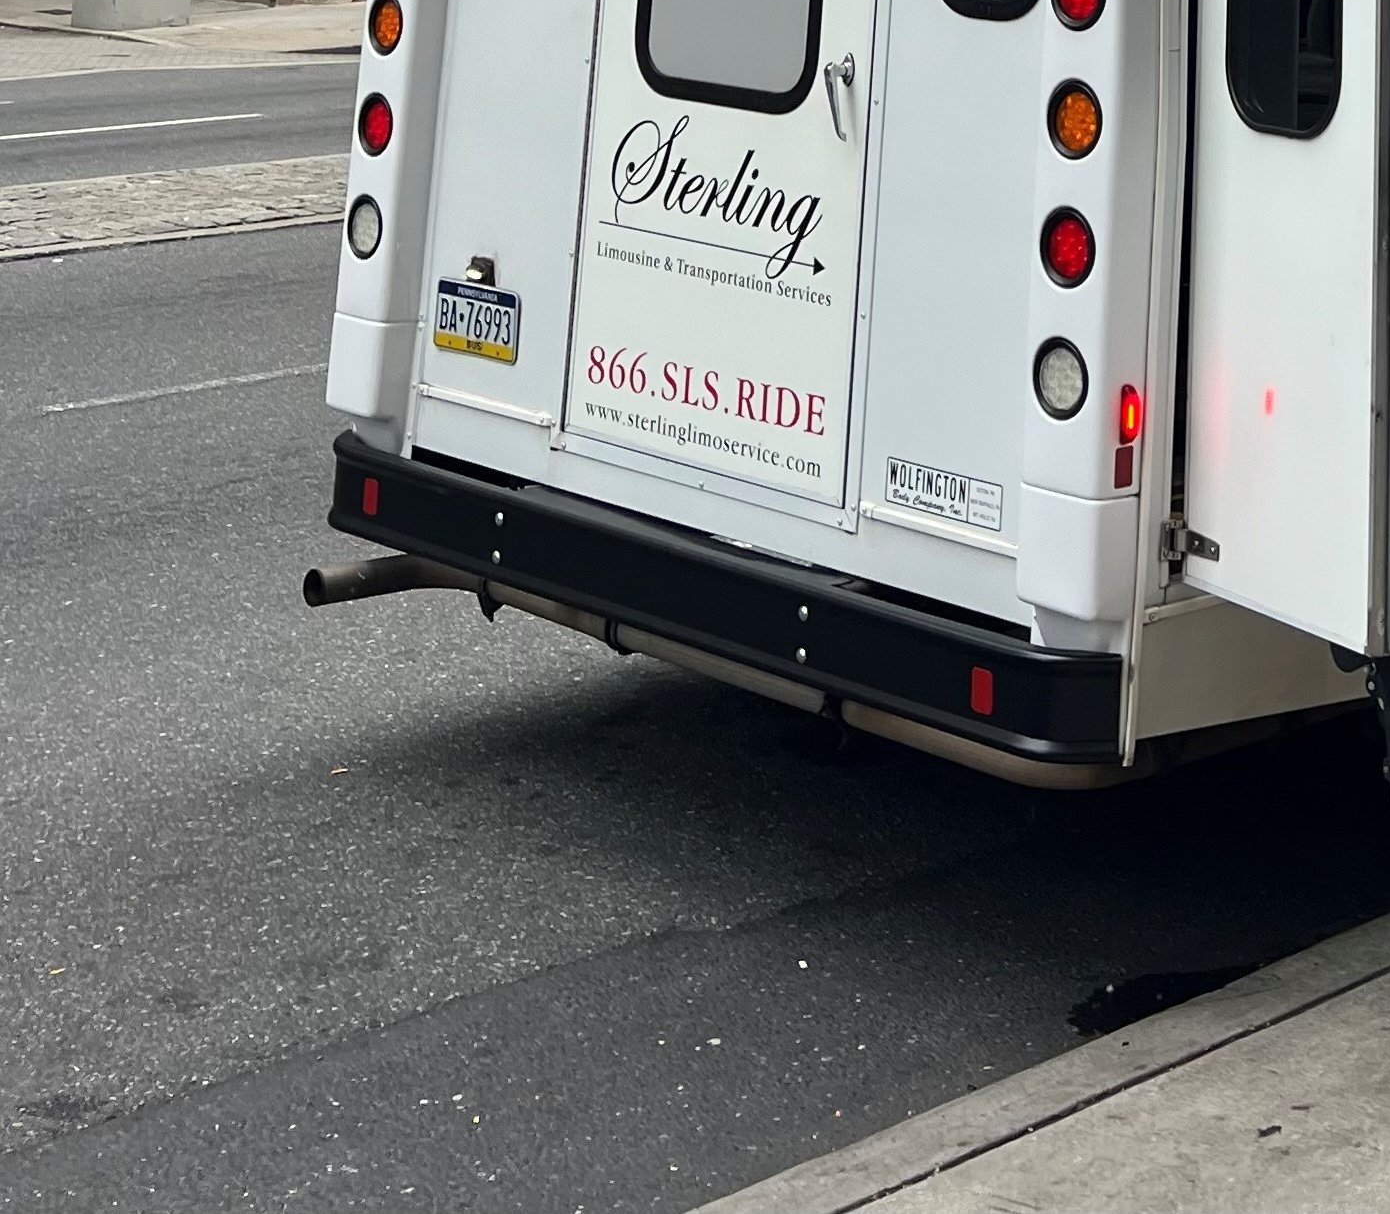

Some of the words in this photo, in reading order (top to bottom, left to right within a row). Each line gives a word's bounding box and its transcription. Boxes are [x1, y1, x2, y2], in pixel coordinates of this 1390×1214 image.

[611, 115, 823, 279] Sterling
[597, 241, 660, 269] Limousine
[664, 256, 674, 272] &
[676, 258, 772, 294] Transportation
[776, 280, 832, 306] Services
[587, 345, 826, 436] 866.SLS.RIDE
[585, 402, 822, 478] www.sterlinglimoservice.com
[890, 460, 967, 504] WOLFINGTON
